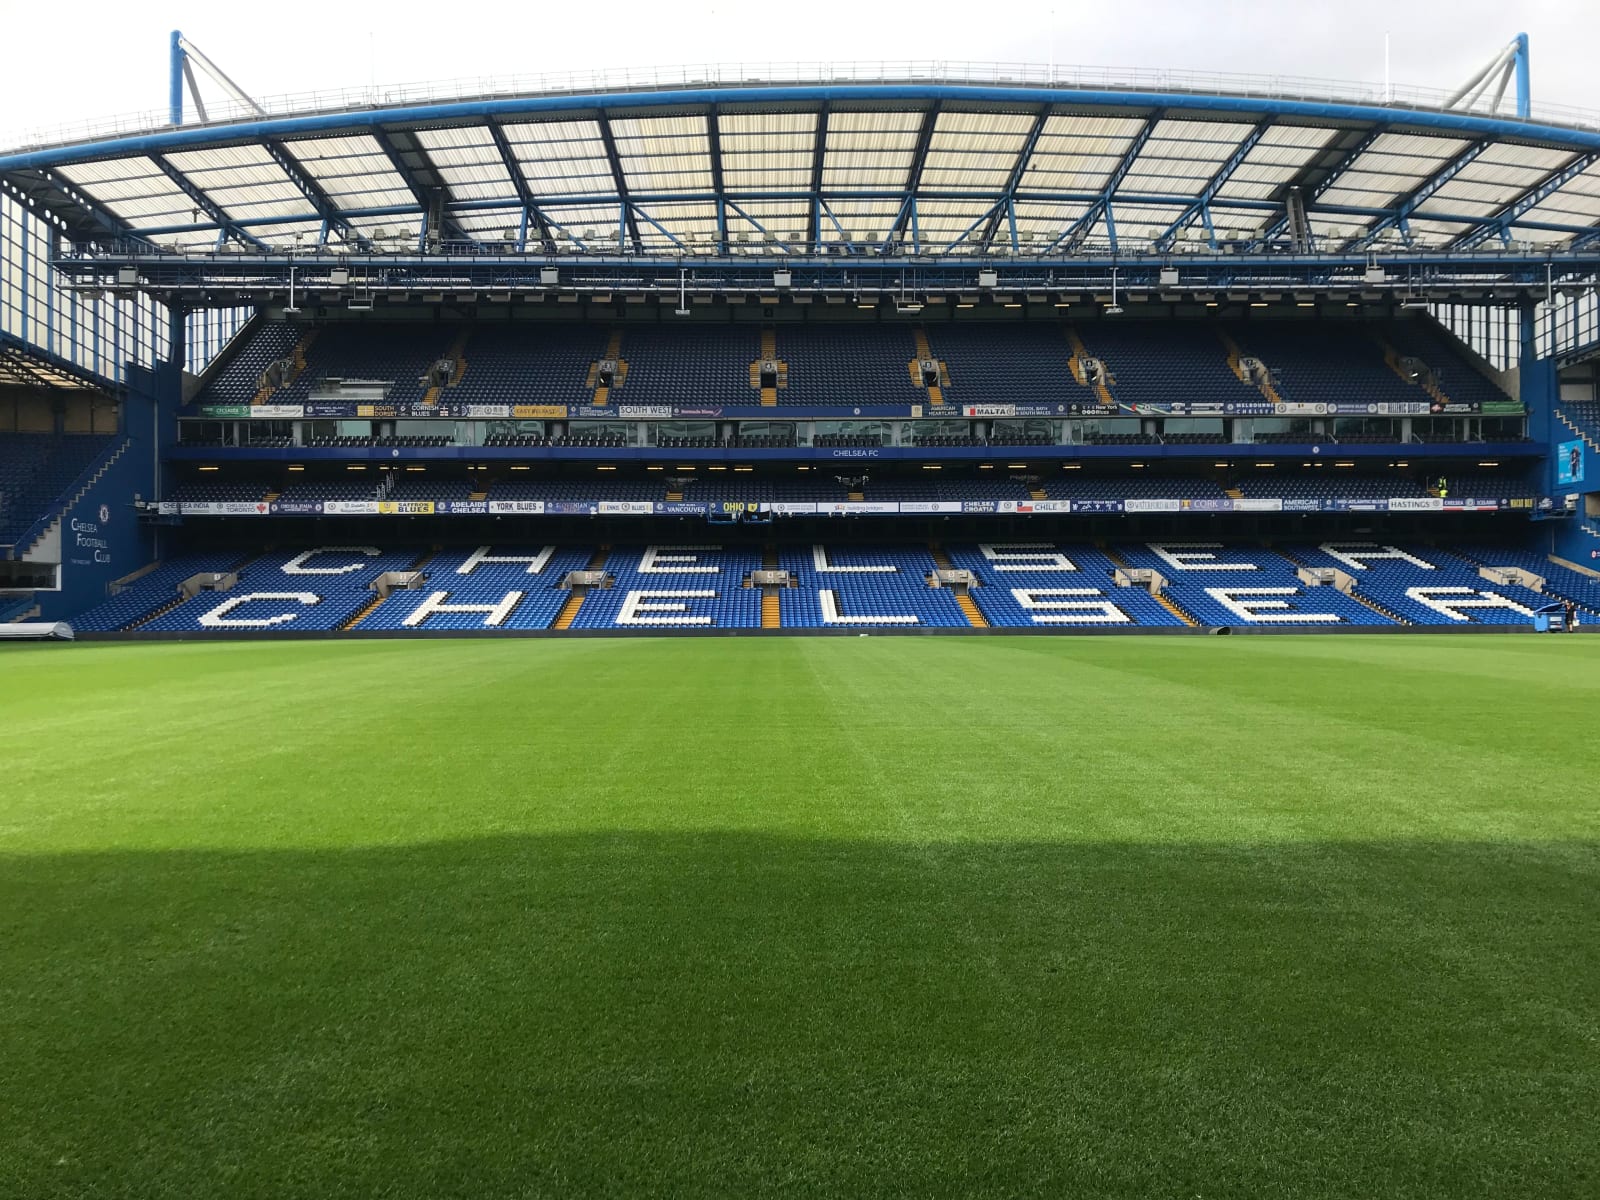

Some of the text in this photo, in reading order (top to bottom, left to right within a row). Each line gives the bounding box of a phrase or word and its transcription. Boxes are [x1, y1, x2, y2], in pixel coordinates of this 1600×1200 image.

[723, 502, 744, 511] OHIO
[71, 518, 97, 533] CHELSEA
[76, 533, 108, 548] FOOTBALL
[94, 550, 110, 563] CLUB
